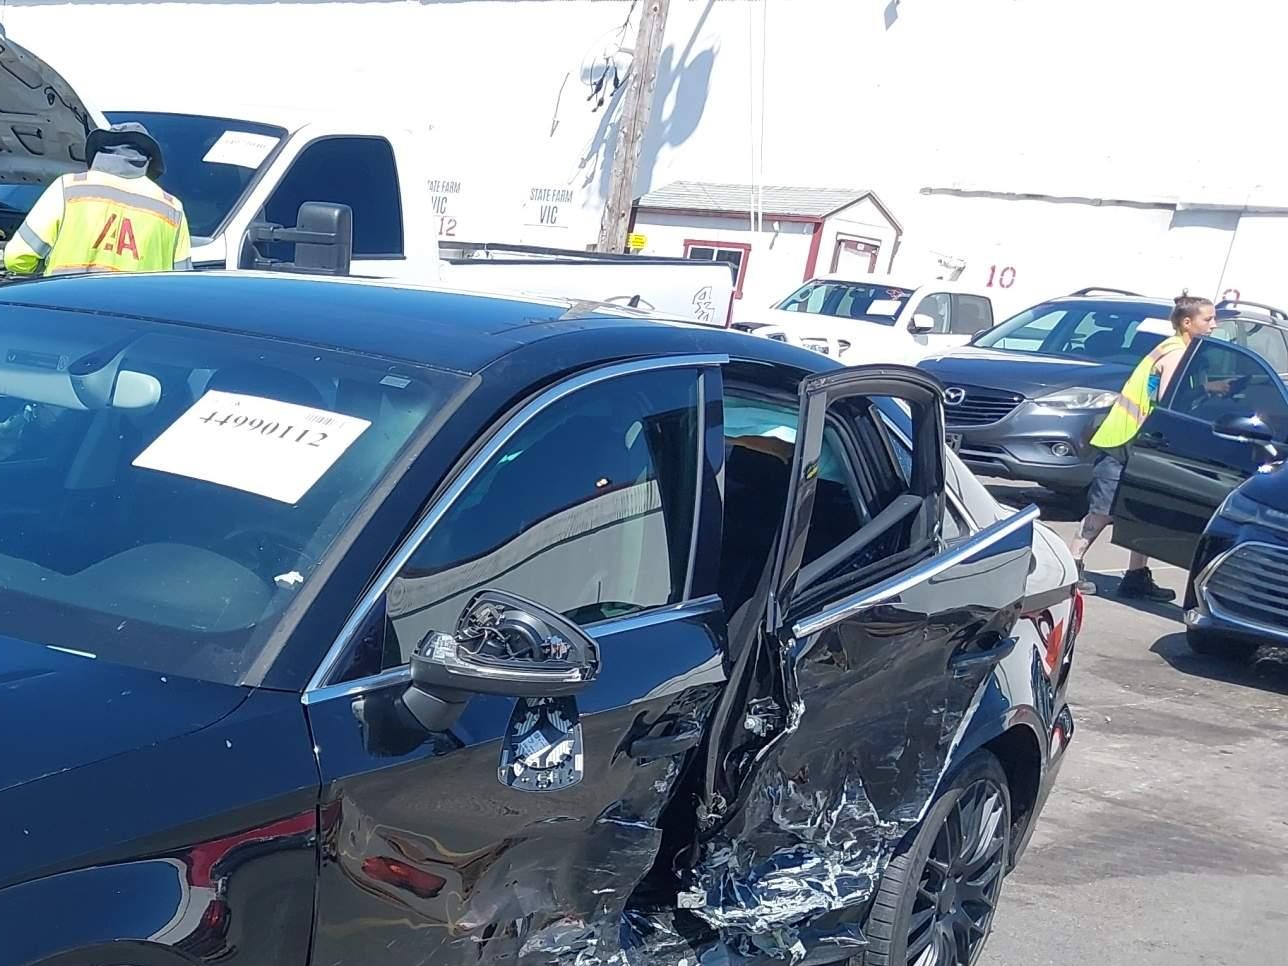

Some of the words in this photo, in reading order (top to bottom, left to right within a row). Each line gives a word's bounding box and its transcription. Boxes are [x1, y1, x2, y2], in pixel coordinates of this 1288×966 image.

[441, 180, 461, 193] FARM
[529, 187, 551, 202] STATE
[552, 188, 573, 203] FARM
[431, 195, 448, 215] VIC
[540, 205, 558, 225] VIC
[438, 215, 457, 237] 12
[985, 264, 1016, 289] 10
[199, 410, 329, 448] 44990112
